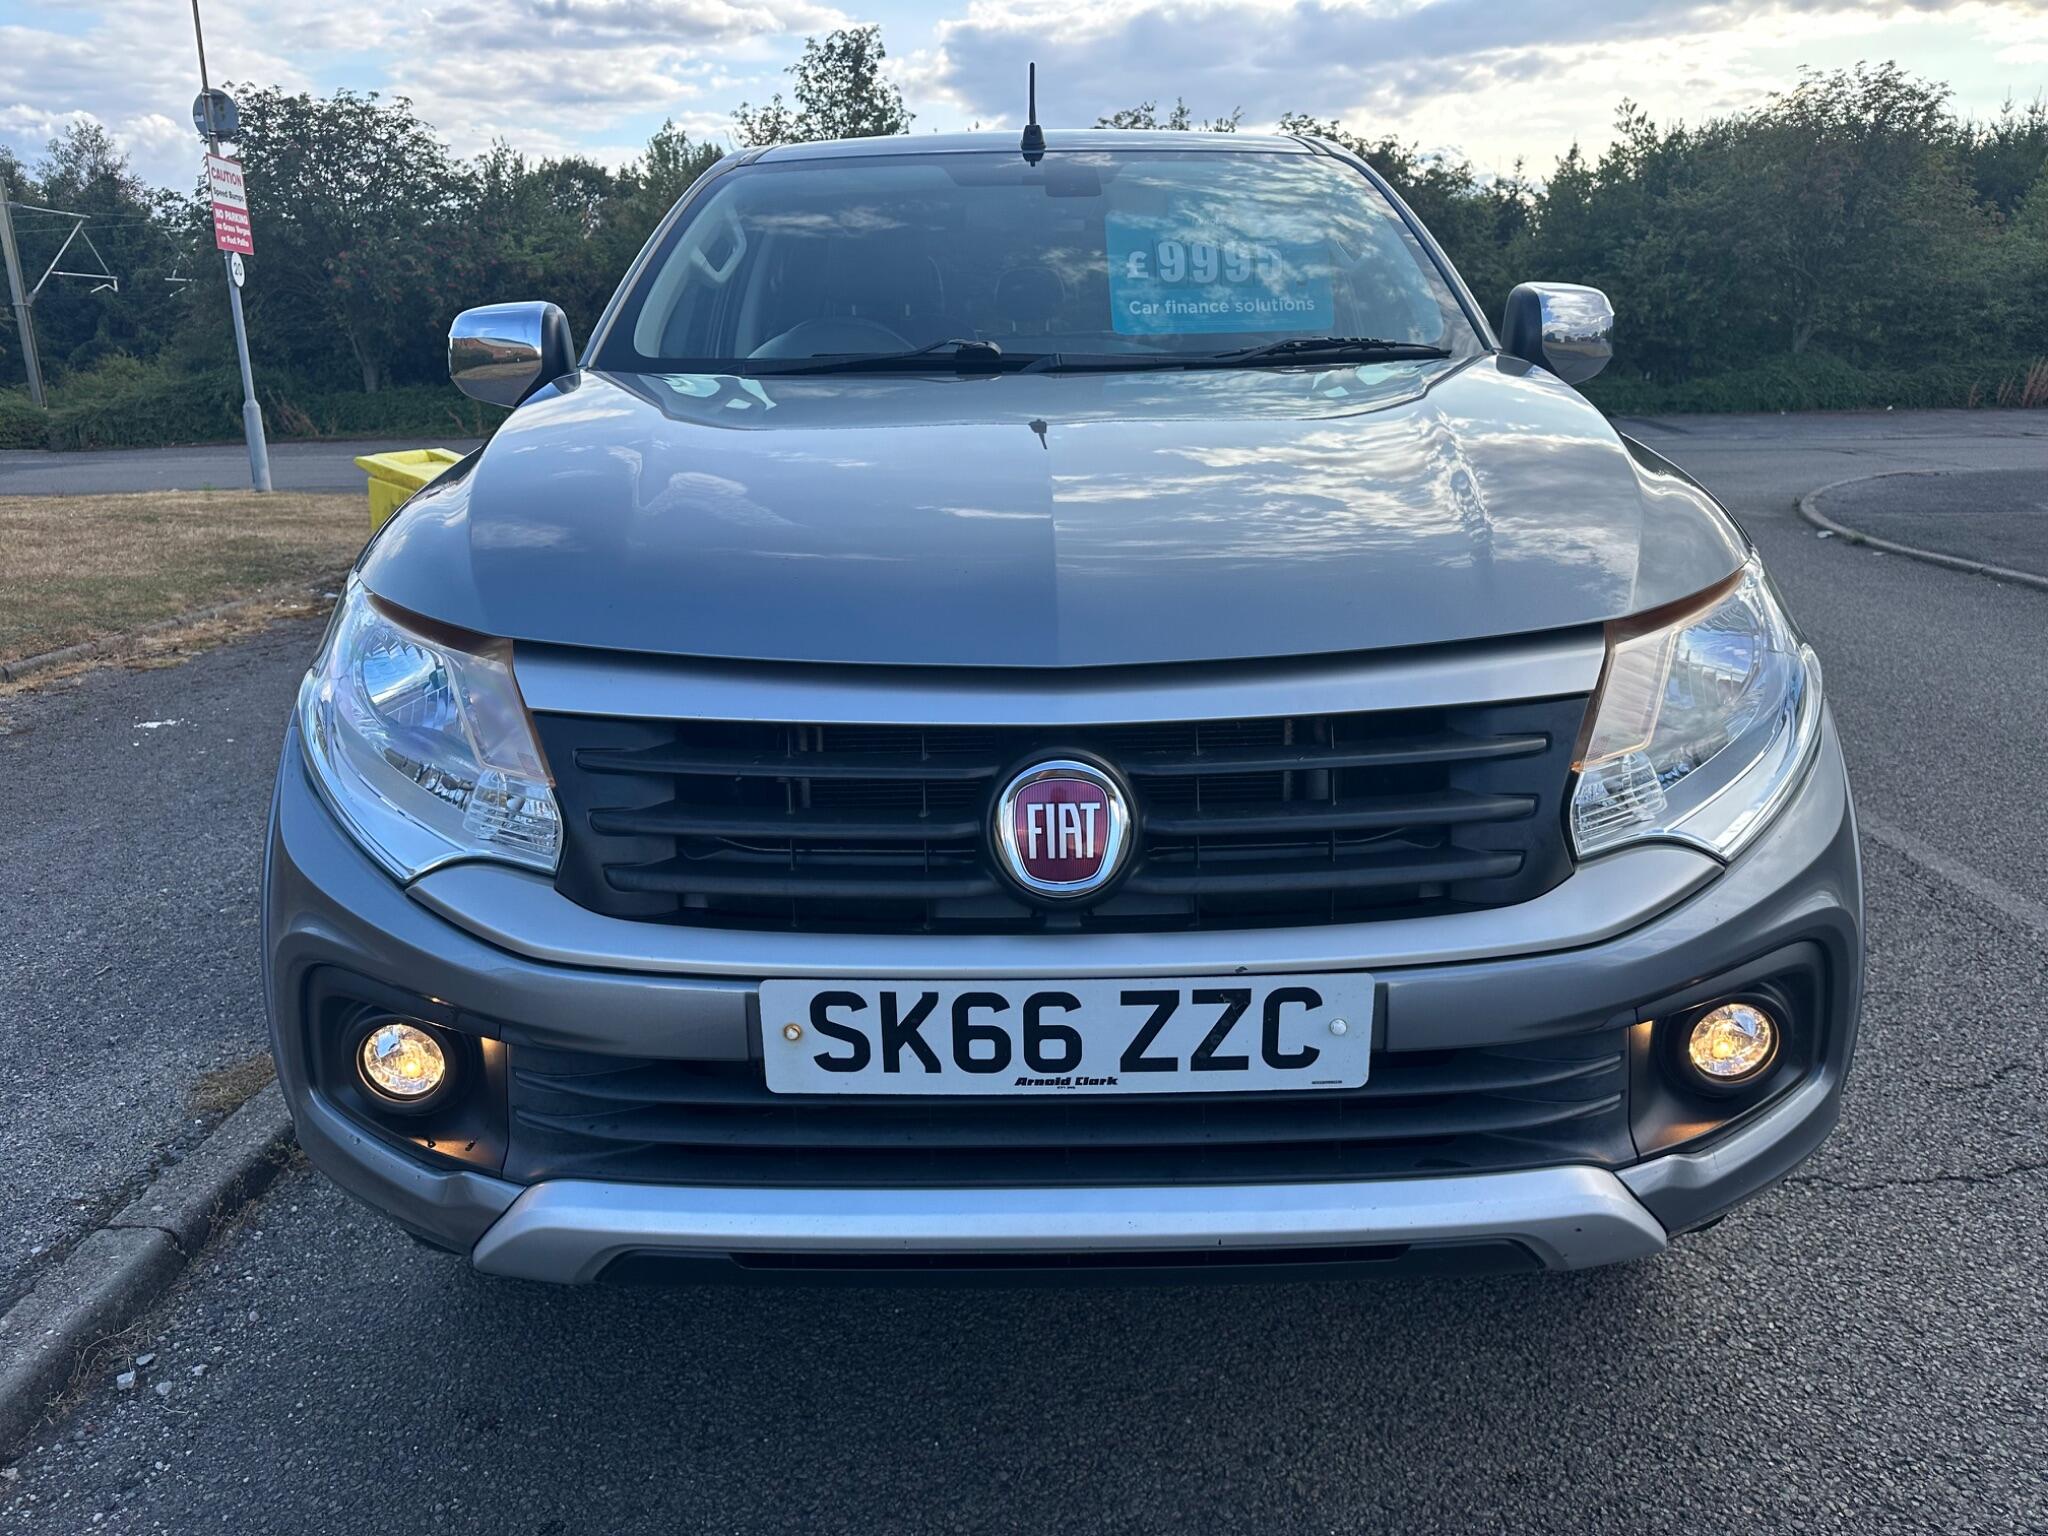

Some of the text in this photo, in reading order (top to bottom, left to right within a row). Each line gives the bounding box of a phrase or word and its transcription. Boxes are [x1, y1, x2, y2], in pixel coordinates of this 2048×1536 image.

[211, 167, 242, 186] CAUTION
[213, 186, 244, 203] Speed Bumps
[215, 208, 248, 225] NO PARKING
[233, 261, 243, 277] 20
[1129, 298, 1315, 316] Car finance solutions
[1026, 802, 1101, 860] FIAT
[808, 986, 1324, 1074] SK66 ZZC
[1014, 1076, 1119, 1087] Arnold Clark
